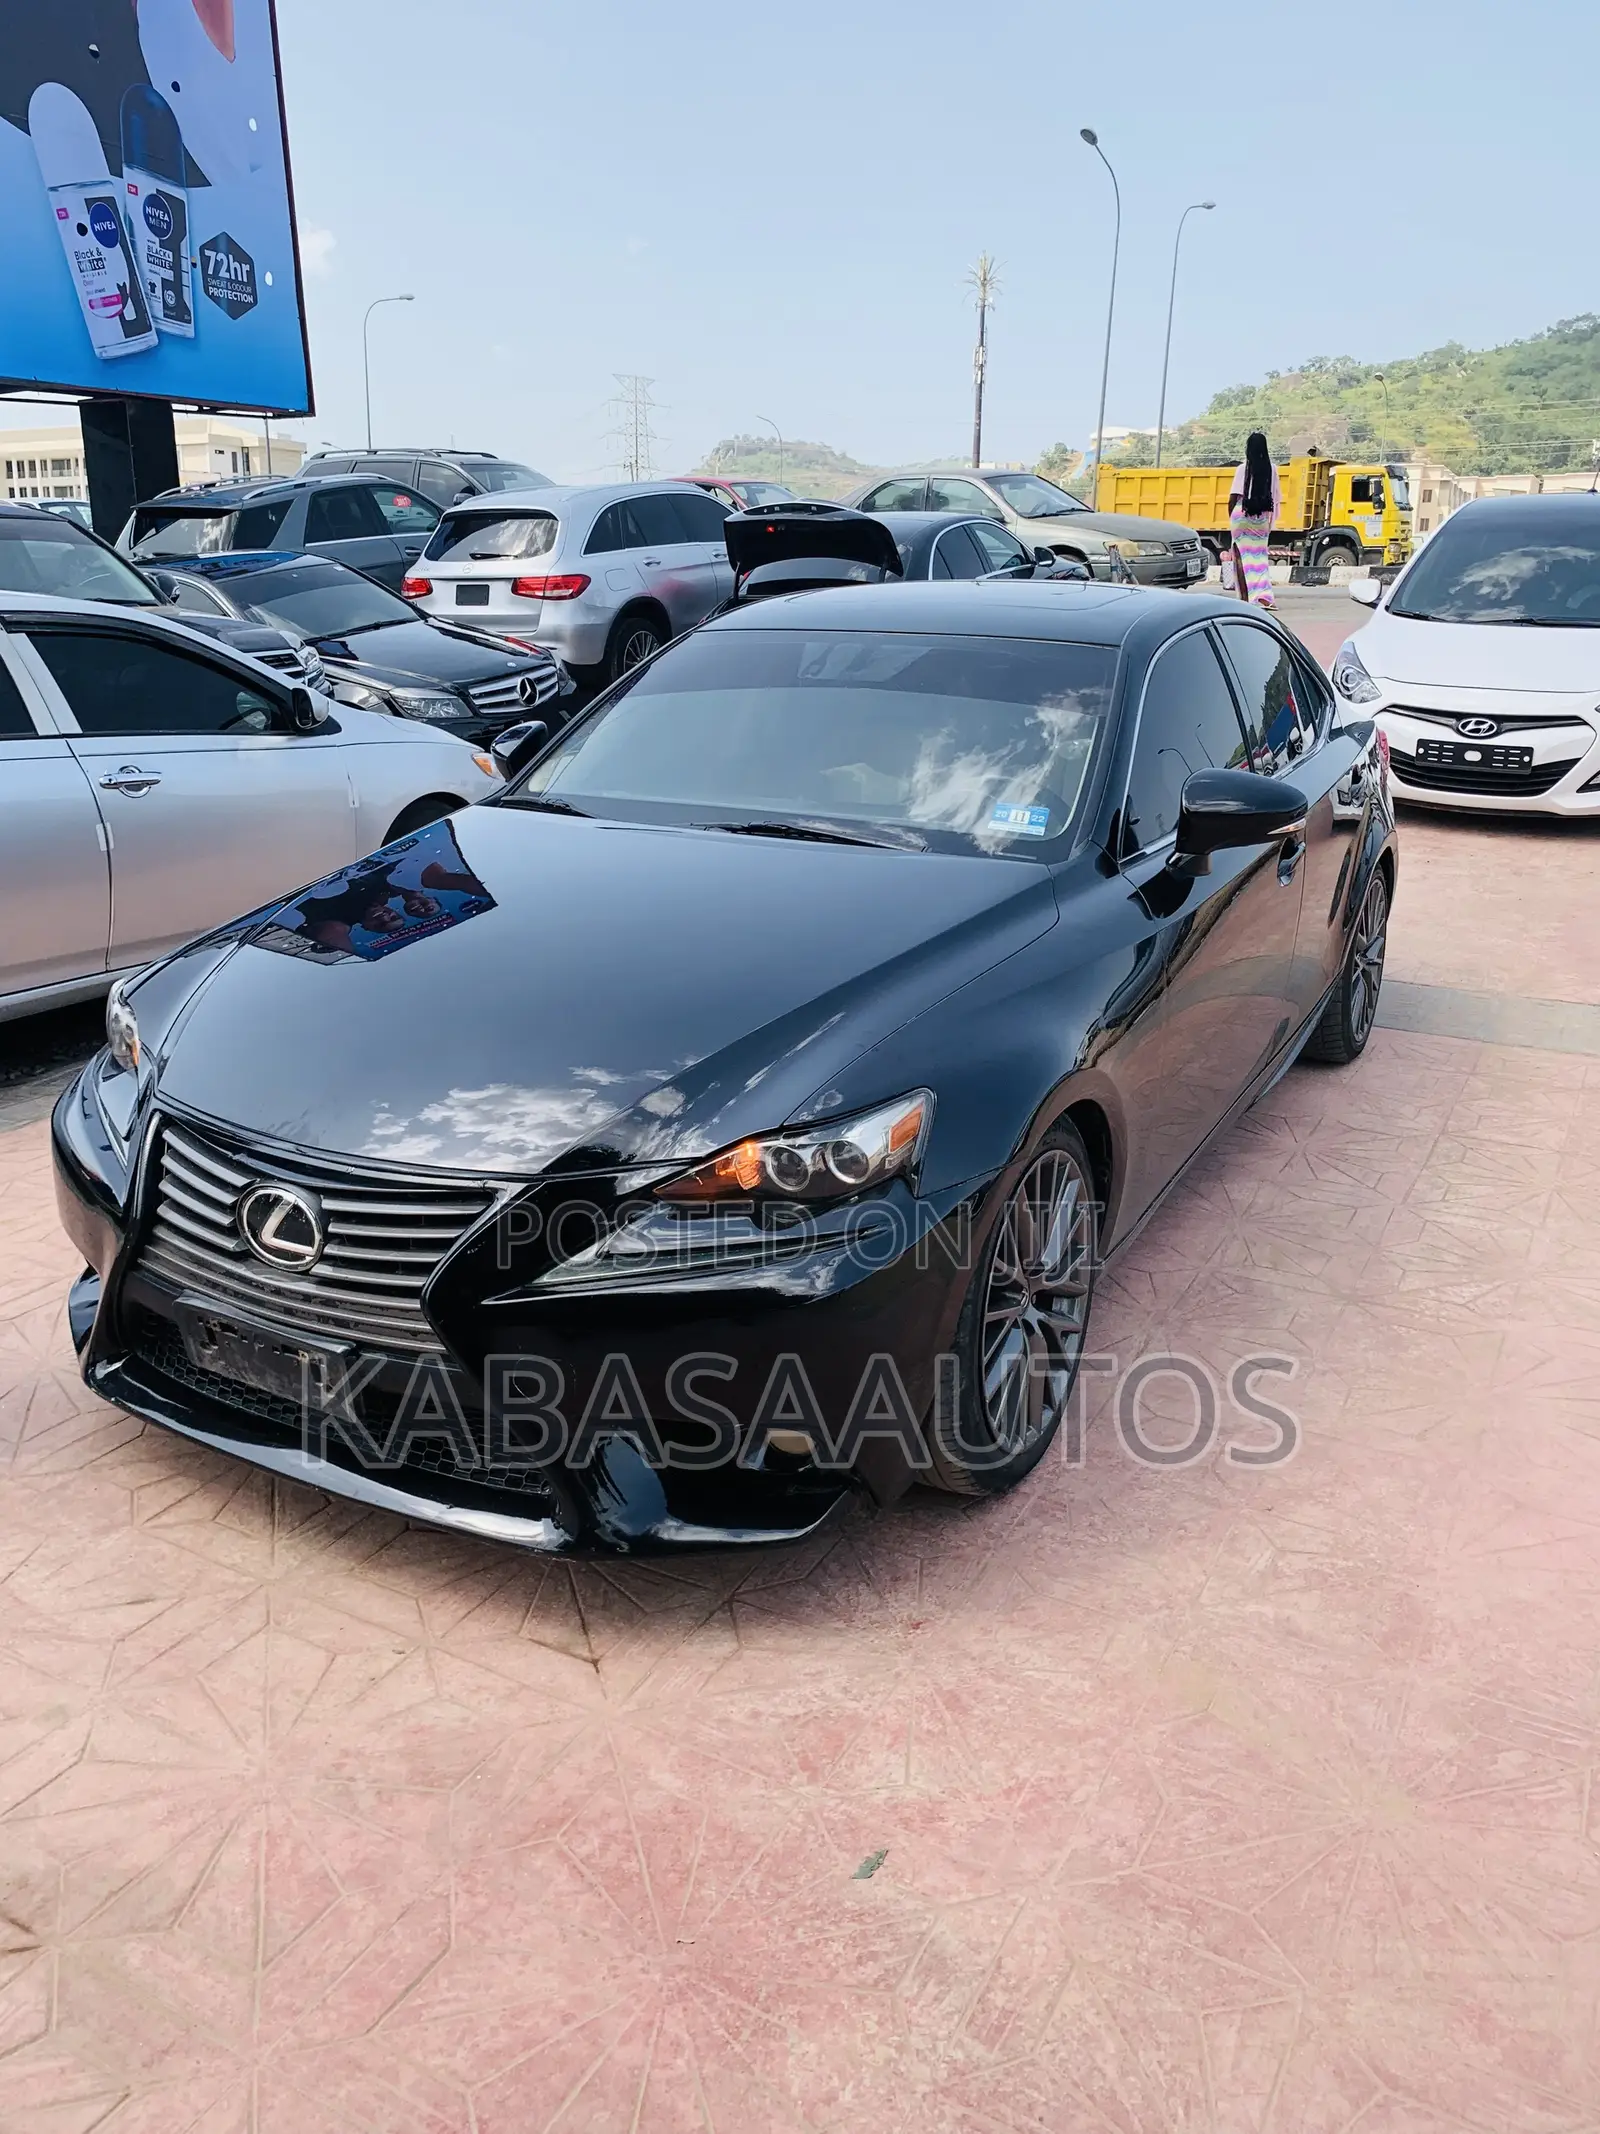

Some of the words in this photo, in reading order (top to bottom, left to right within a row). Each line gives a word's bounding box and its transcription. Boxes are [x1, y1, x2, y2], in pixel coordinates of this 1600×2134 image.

[145, 205, 169, 222] NIVEA
[94, 221, 116, 231] NIVEA
[149, 216, 167, 229] MEN
[74, 249, 95, 260] Black
[147, 245, 167, 258] BLACK
[147, 255, 171, 269] WHITE
[204, 249, 250, 282] 72hr
[208, 278, 227, 288] SWEAT
[231, 283, 252, 294] ODOUR
[208, 286, 254, 303] PROTECTION
[1032, 814, 1044, 822] 22
